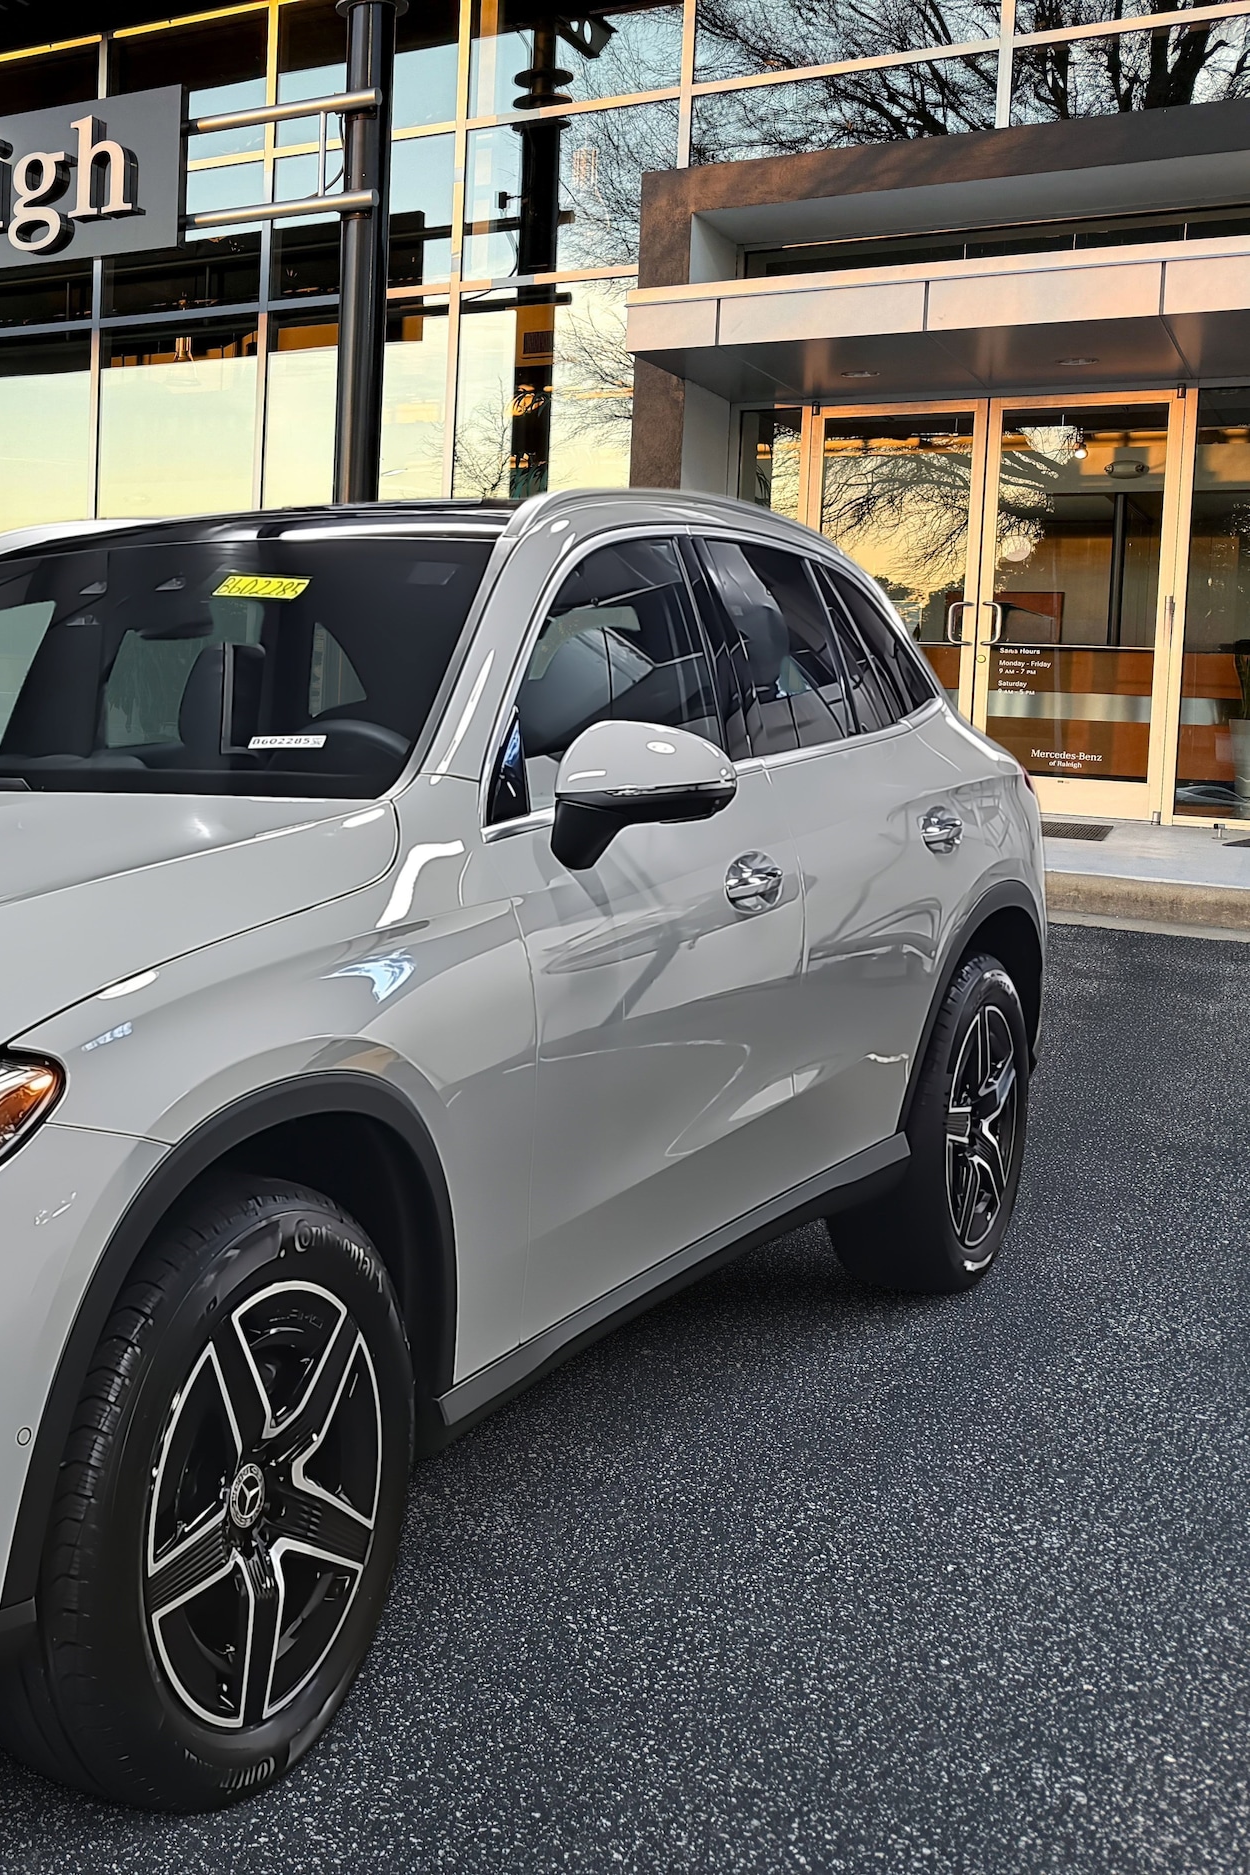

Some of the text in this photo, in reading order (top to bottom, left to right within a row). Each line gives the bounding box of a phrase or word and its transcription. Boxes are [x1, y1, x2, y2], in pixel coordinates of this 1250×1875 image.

[216, 577, 307, 597] B602285
[999, 660, 1025, 668] Monday
[1030, 660, 1052, 669] Friday
[997, 680, 1028, 689] Saturday
[1030, 748, 1103, 762] Mercedes-Benz
[1057, 760, 1083, 769] Raleigh
